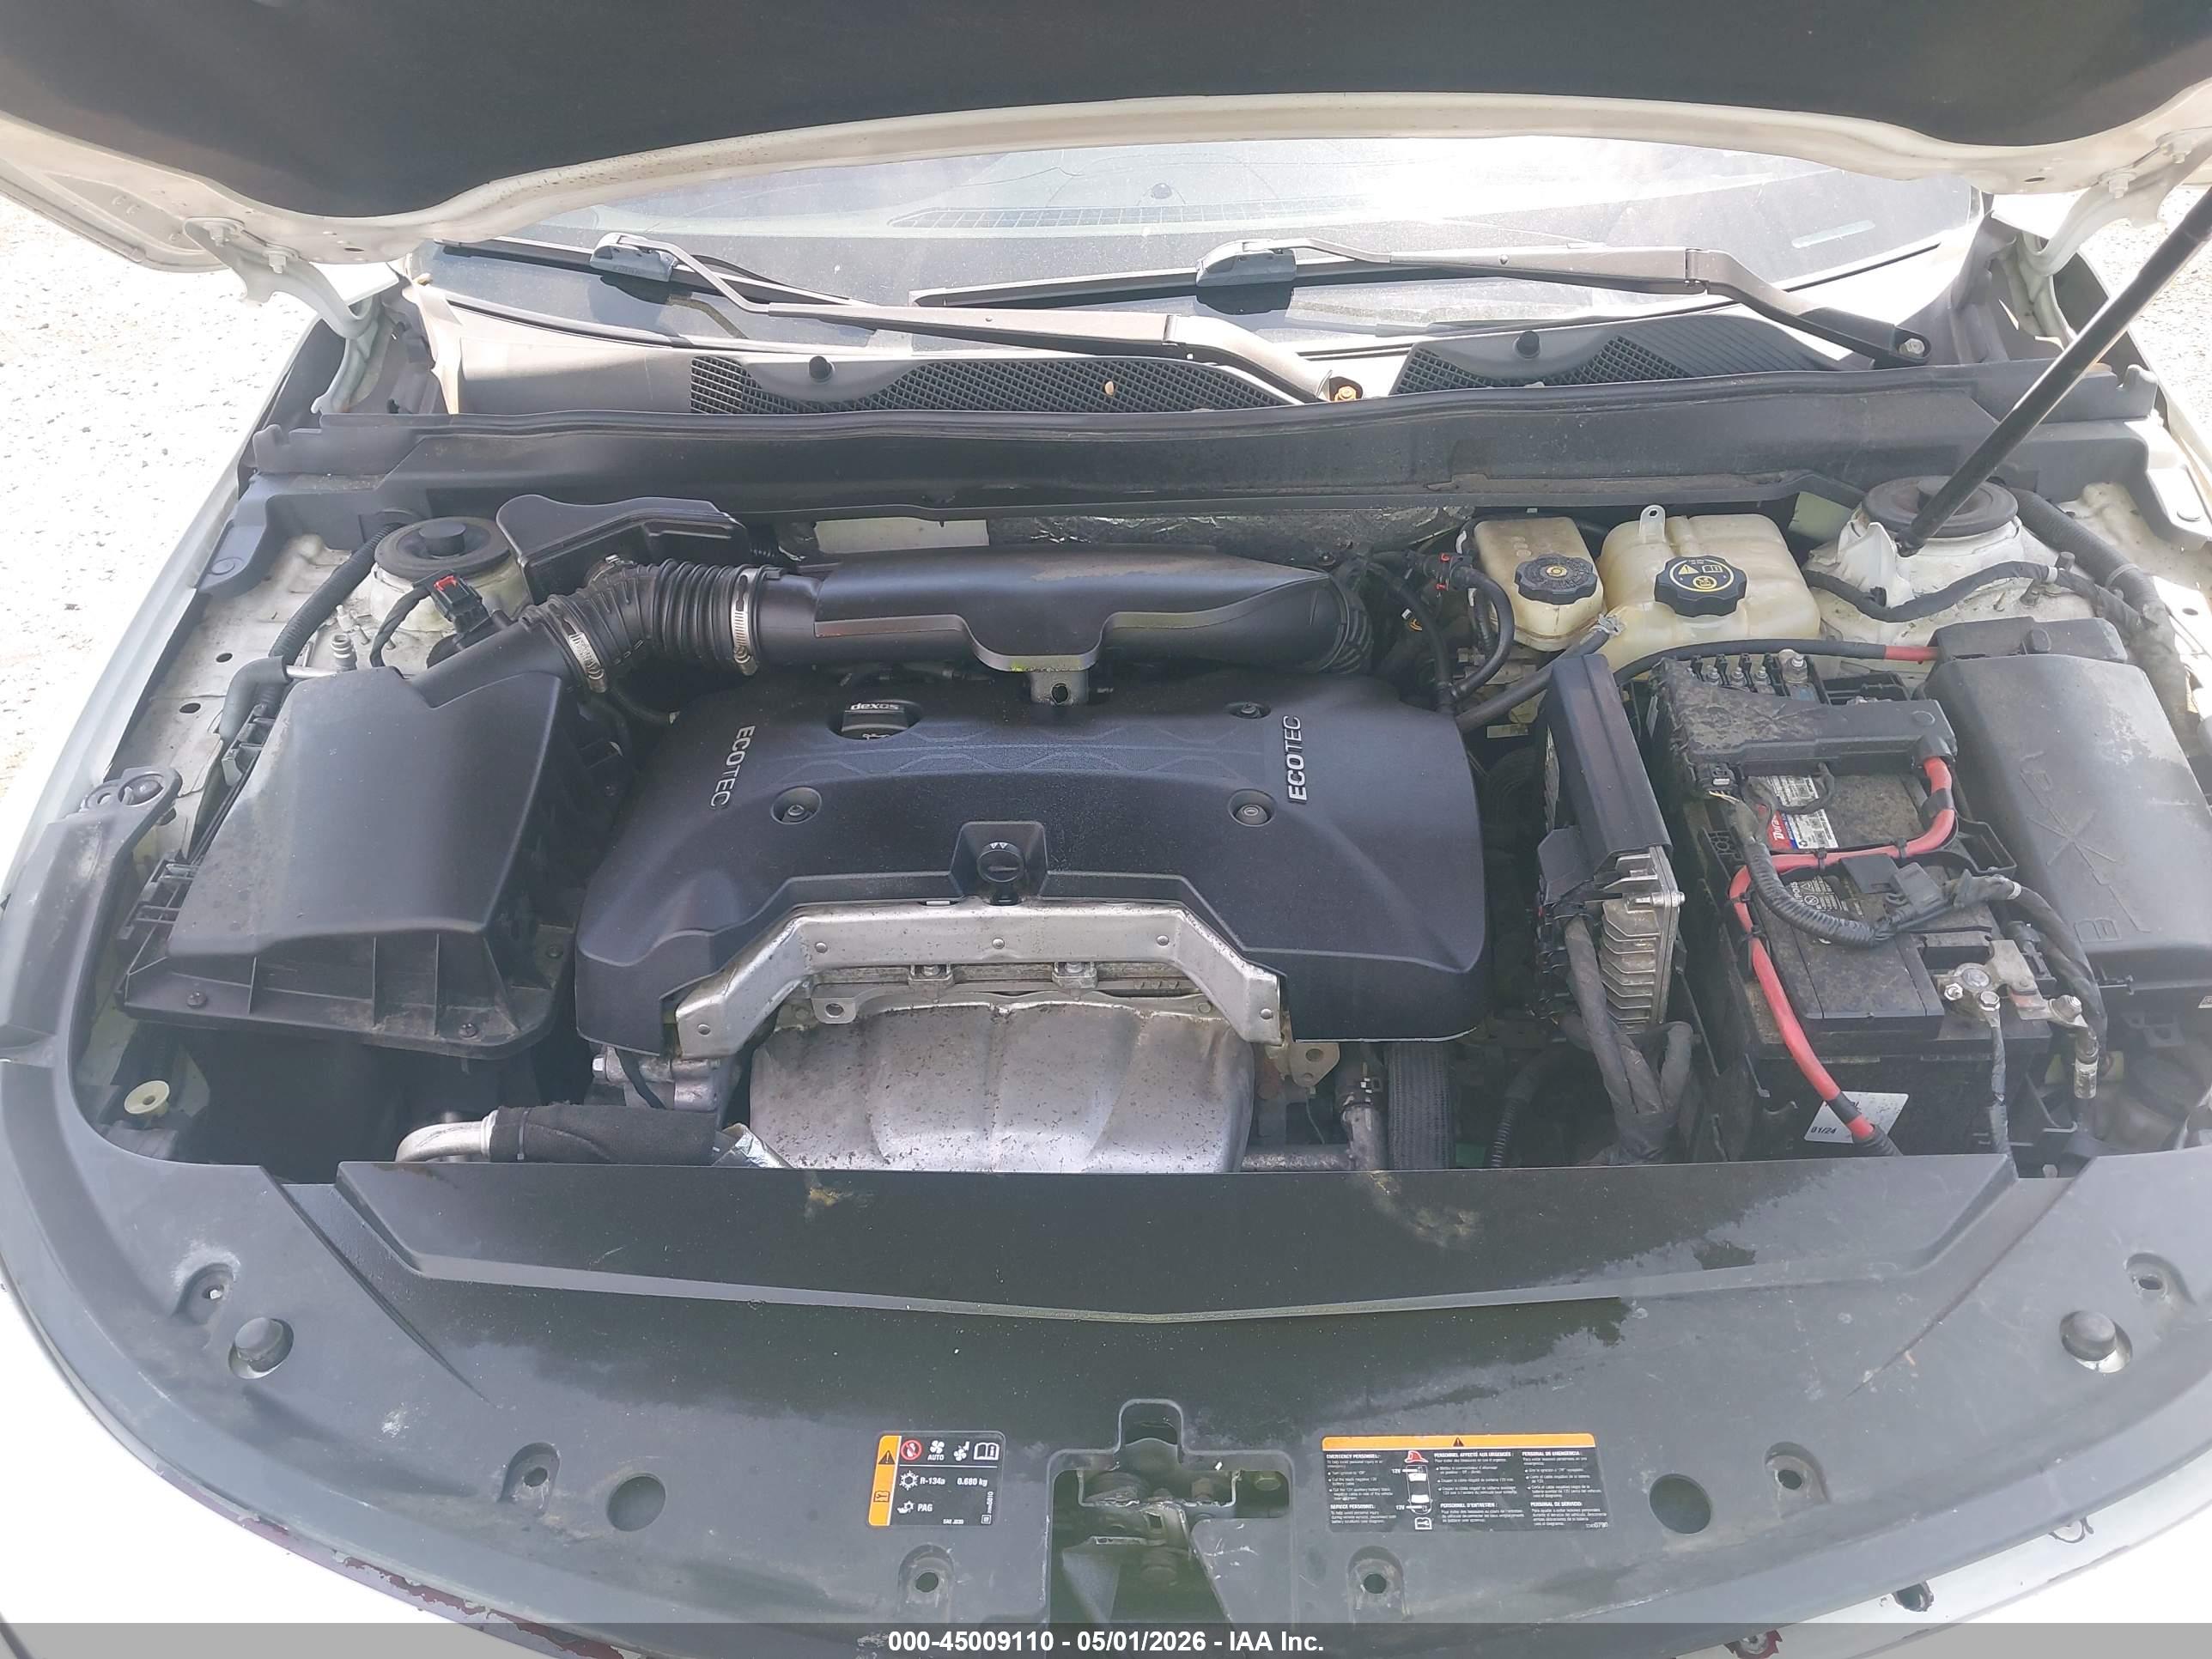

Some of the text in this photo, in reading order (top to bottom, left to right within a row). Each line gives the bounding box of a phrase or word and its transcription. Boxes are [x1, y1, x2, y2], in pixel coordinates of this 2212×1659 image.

[710, 725, 756, 808] ECOTEC
[1283, 715, 1307, 801] ECOTEC
[978, 1478, 988, 1487] kg
[917, 1504, 933, 1512] PAG
